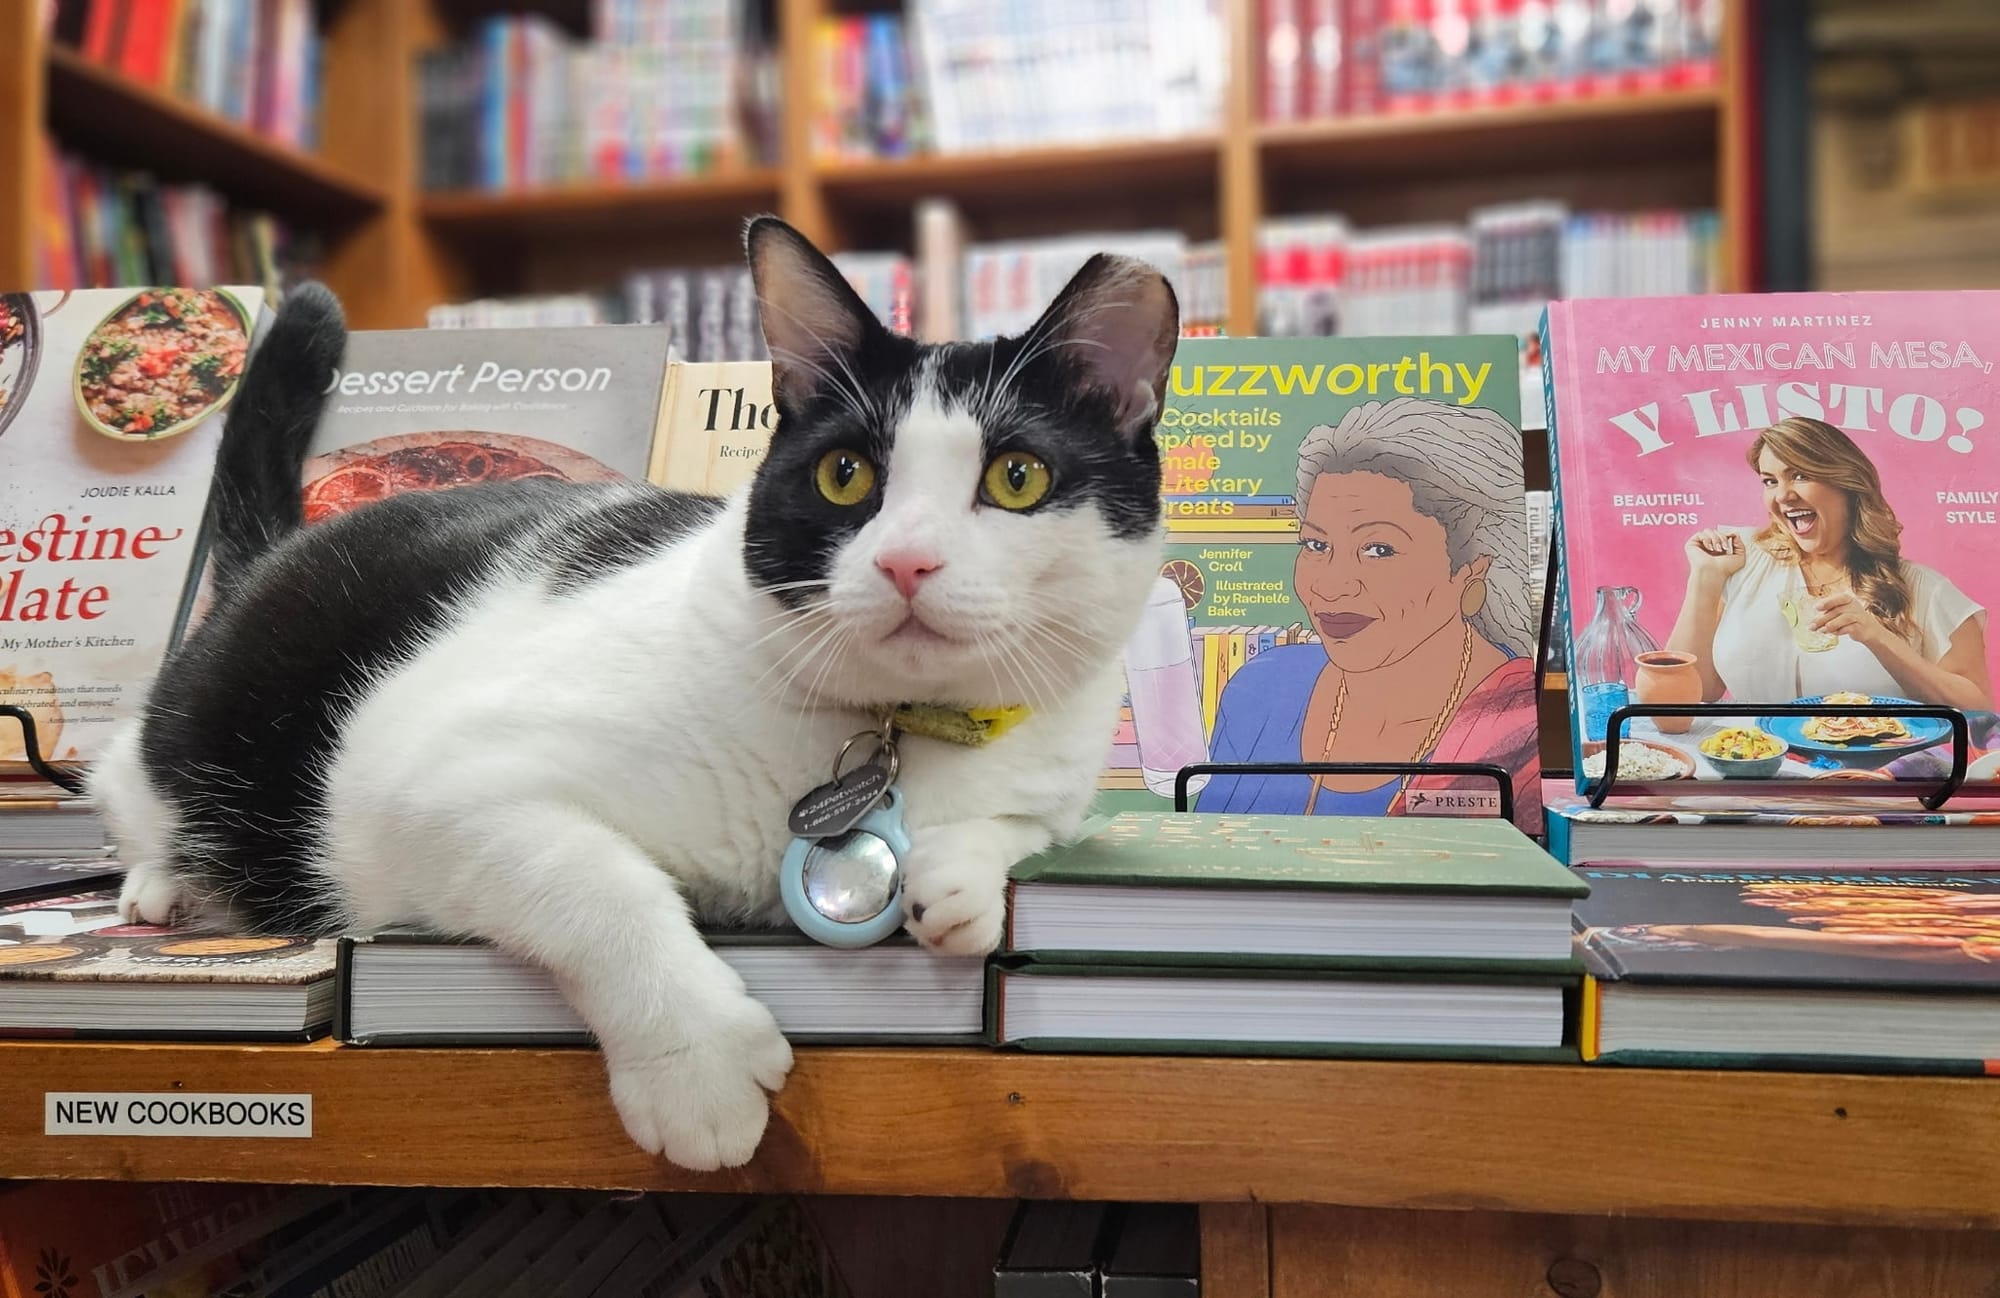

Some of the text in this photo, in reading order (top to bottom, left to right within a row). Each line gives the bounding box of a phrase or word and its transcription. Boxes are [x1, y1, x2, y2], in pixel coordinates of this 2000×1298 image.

[1700, 314, 1873, 329] JENNY MARTINEZ
[1596, 340, 1994, 375] MY MEXICAN MESA,
[468, 361, 612, 393] Person
[1167, 351, 1492, 405] uzzworthy
[1161, 407, 1282, 427] Cocktails
[1608, 381, 1985, 458] Y LISTO!
[1240, 430, 1272, 452] by
[720, 445, 768, 459] Recipe
[81, 485, 177, 498] JOUDIE KALLA
[1161, 475, 1263, 497] Literary
[1613, 493, 1705, 507] BEAUTIFUL
[1936, 491, 1999, 504] FAMILY
[1165, 498, 1234, 515] reats
[1622, 513, 1699, 526] FLAVORS
[1946, 511, 1997, 524] STYLE
[1199, 549, 1252, 560] Jennifer
[1208, 561, 1243, 572] Croll
[1216, 580, 1283, 591] Illustrated
[0, 569, 110, 622] late
[1213, 592, 1290, 606] by Rachelle
[1207, 606, 1247, 617] Baker
[1, 638, 22, 652] My
[84, 635, 135, 647] Kitchen
[1435, 796, 1497, 807] PRESTE
[56, 1101, 305, 1125] NEW COOKBOOKS
